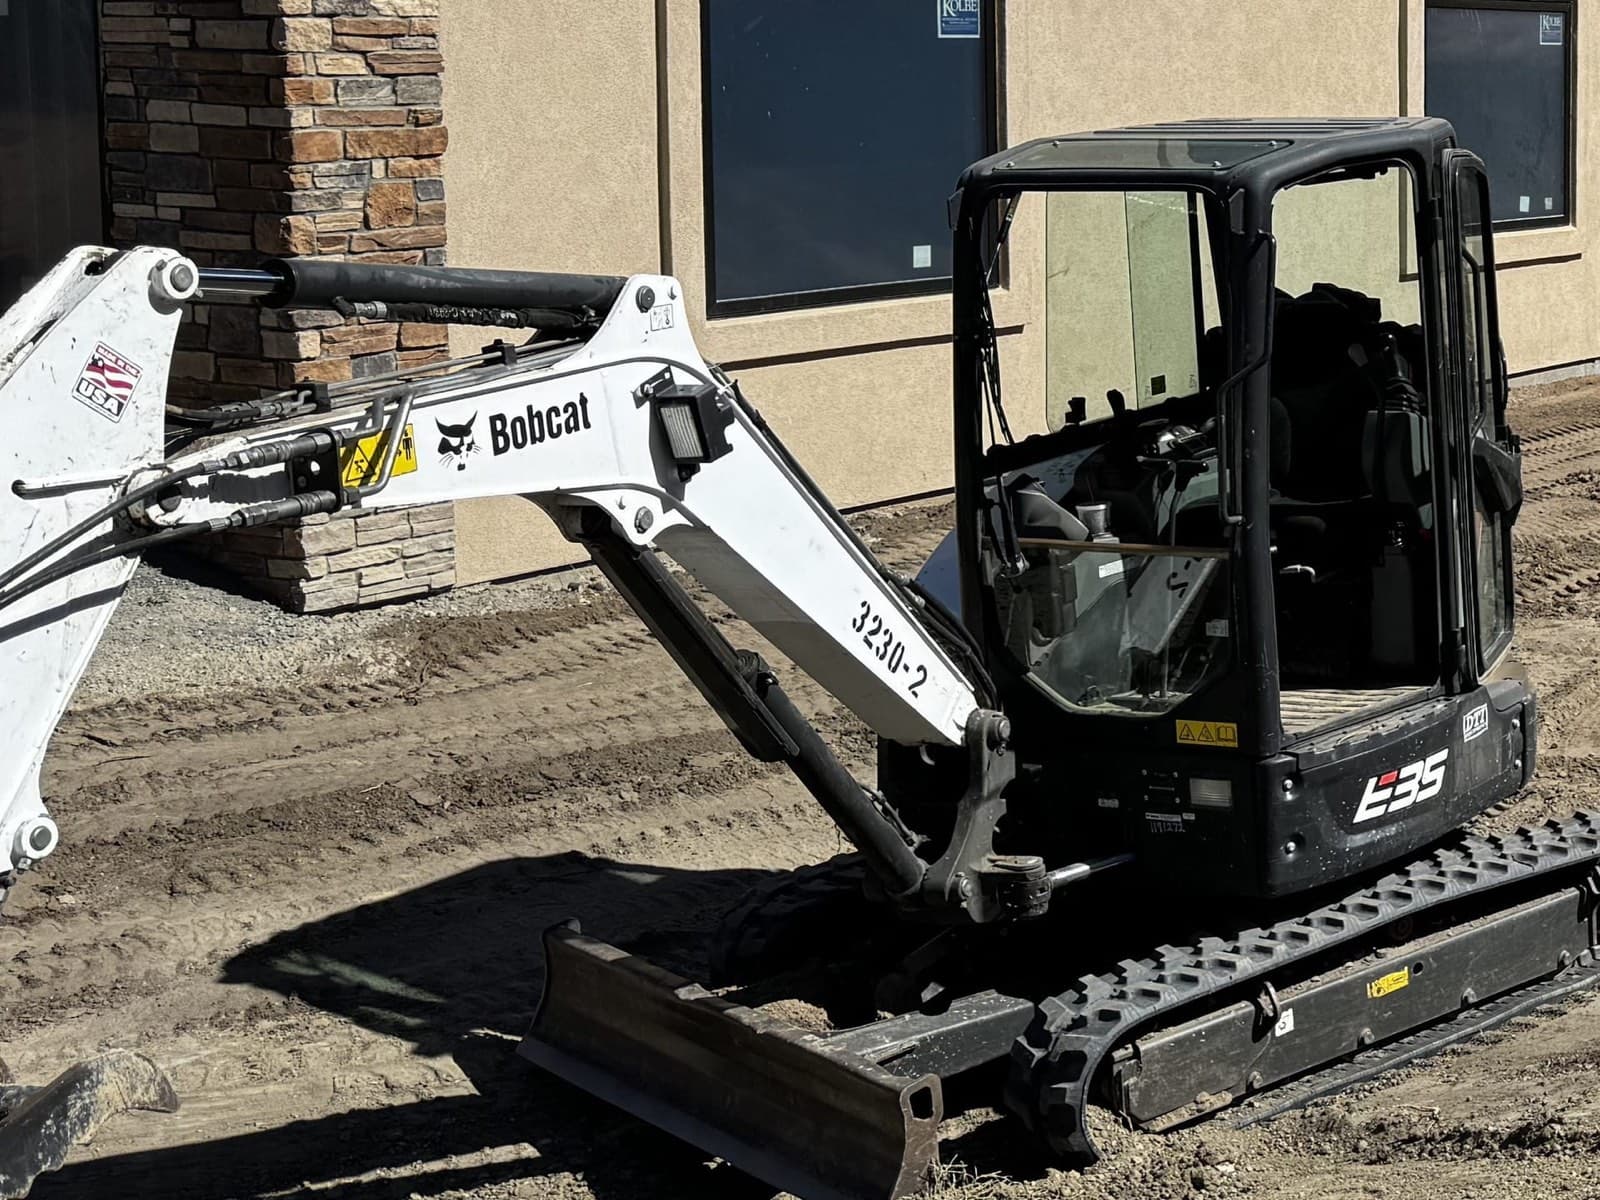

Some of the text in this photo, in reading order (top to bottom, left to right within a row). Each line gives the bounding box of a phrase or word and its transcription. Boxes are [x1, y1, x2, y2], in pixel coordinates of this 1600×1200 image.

[78, 380, 119, 417] USA
[488, 391, 592, 457] Bobcat
[852, 600, 928, 699] 3230-2
[1352, 748, 1449, 824] E35
